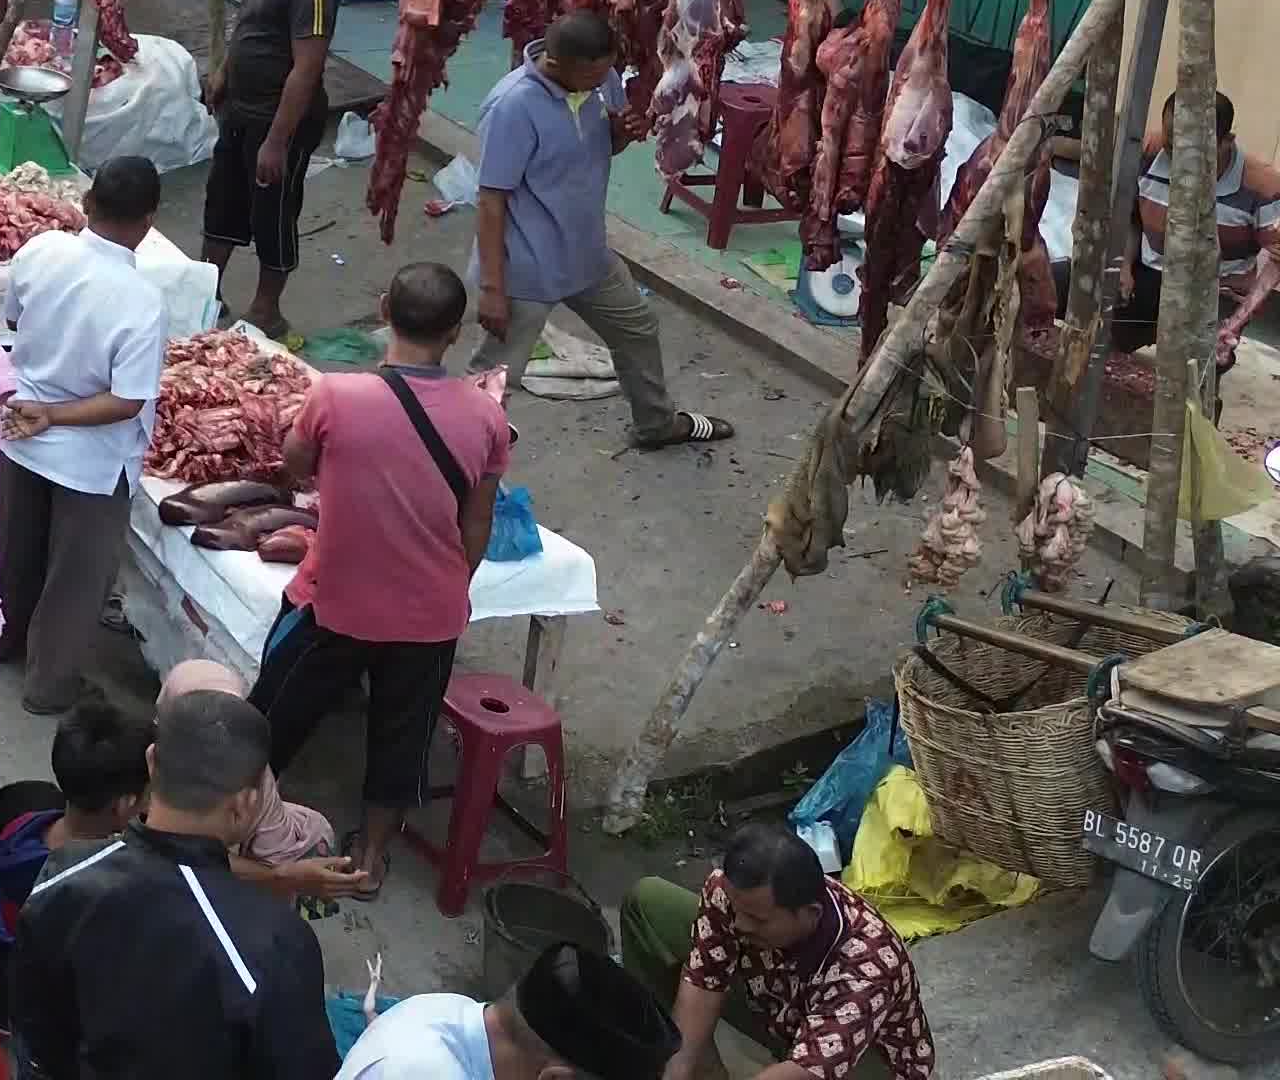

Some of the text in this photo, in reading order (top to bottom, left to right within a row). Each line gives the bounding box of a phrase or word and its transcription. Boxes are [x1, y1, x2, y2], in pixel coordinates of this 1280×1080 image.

[1083, 809, 1201, 874] BL 5587 QR
